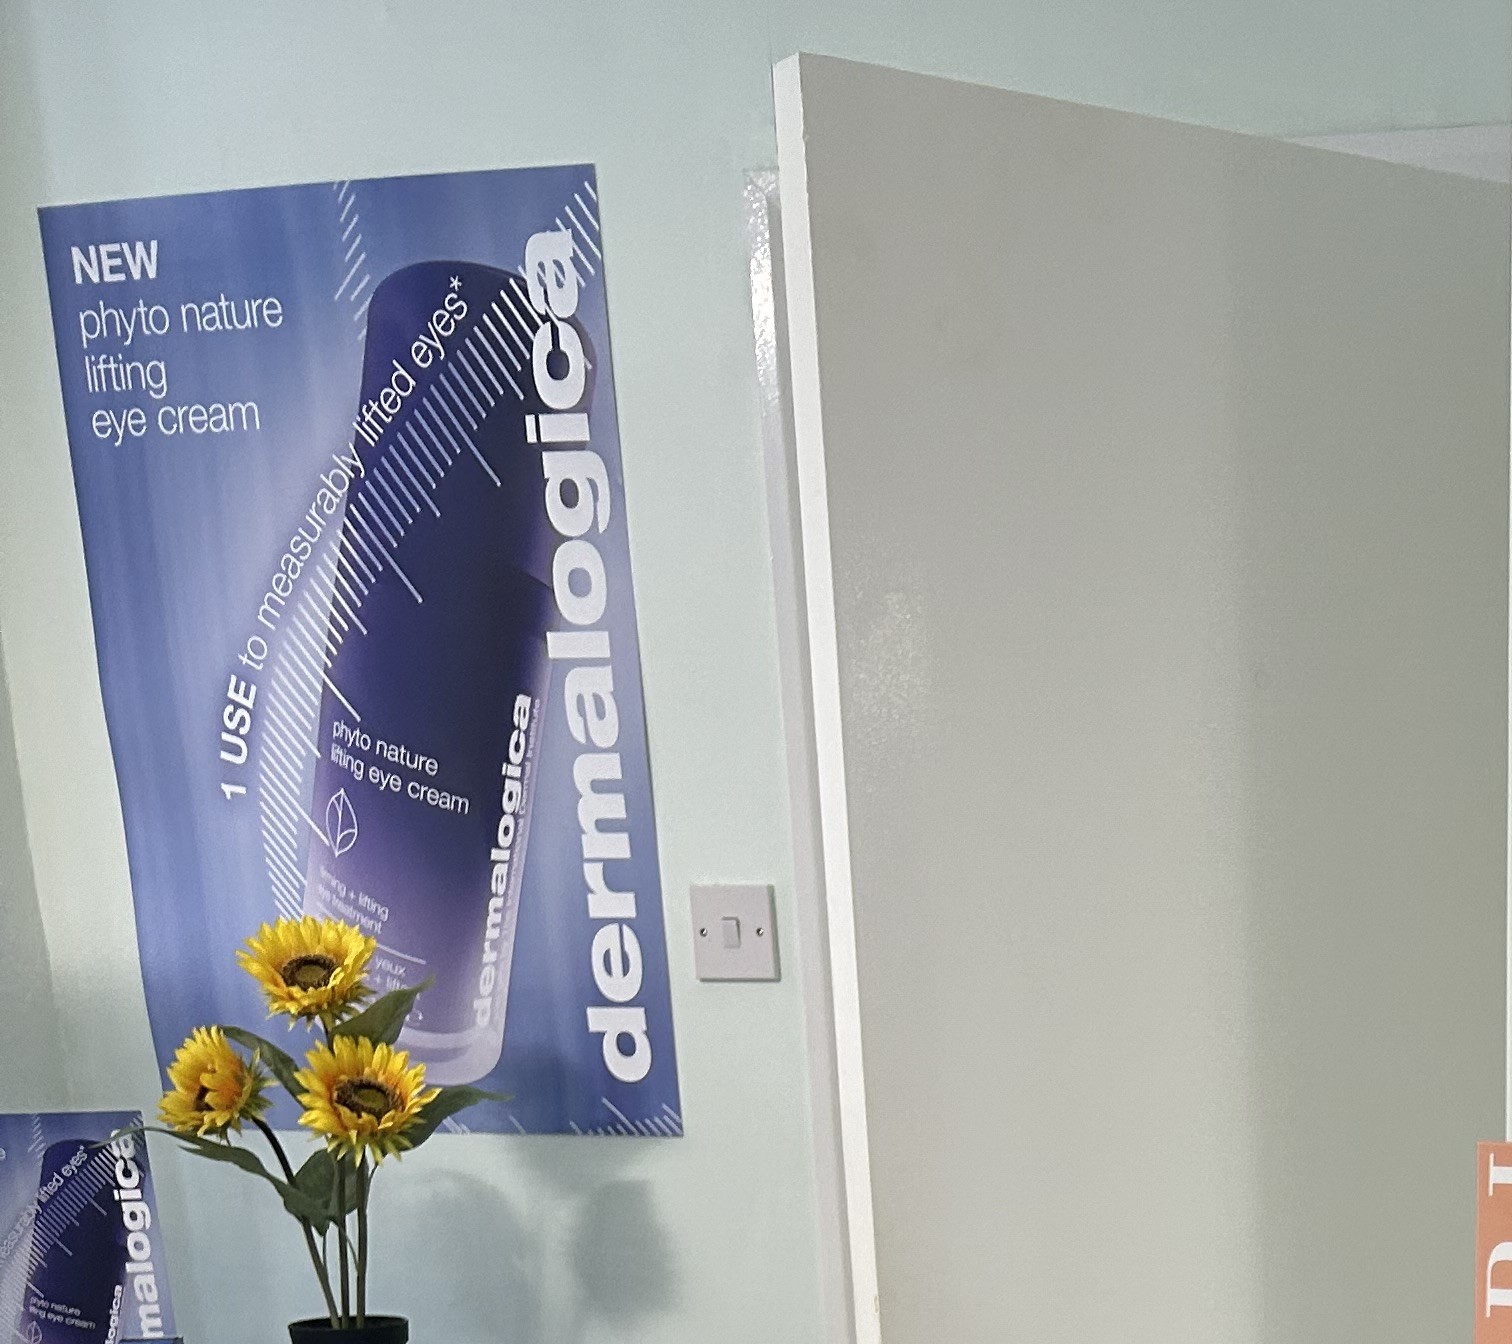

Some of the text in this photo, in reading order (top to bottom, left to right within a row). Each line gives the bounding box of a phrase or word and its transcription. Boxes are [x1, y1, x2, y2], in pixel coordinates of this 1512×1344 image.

[71, 240, 158, 285] NEW
[79, 293, 284, 349] phyto nature
[84, 353, 168, 400] lifting
[352, 359, 417, 447] lifted
[91, 401, 260, 447] eye cream
[257, 442, 366, 631] measurably
[237, 634, 269, 671] to
[524, 228, 653, 1083] dermalogica
[219, 674, 257, 765] USE
[332, 720, 439, 777] phyto nature
[220, 782, 247, 800] 1
[368, 763, 403, 794] eye
[407, 780, 470, 815] cream
[473, 693, 532, 1028] dermalogica
